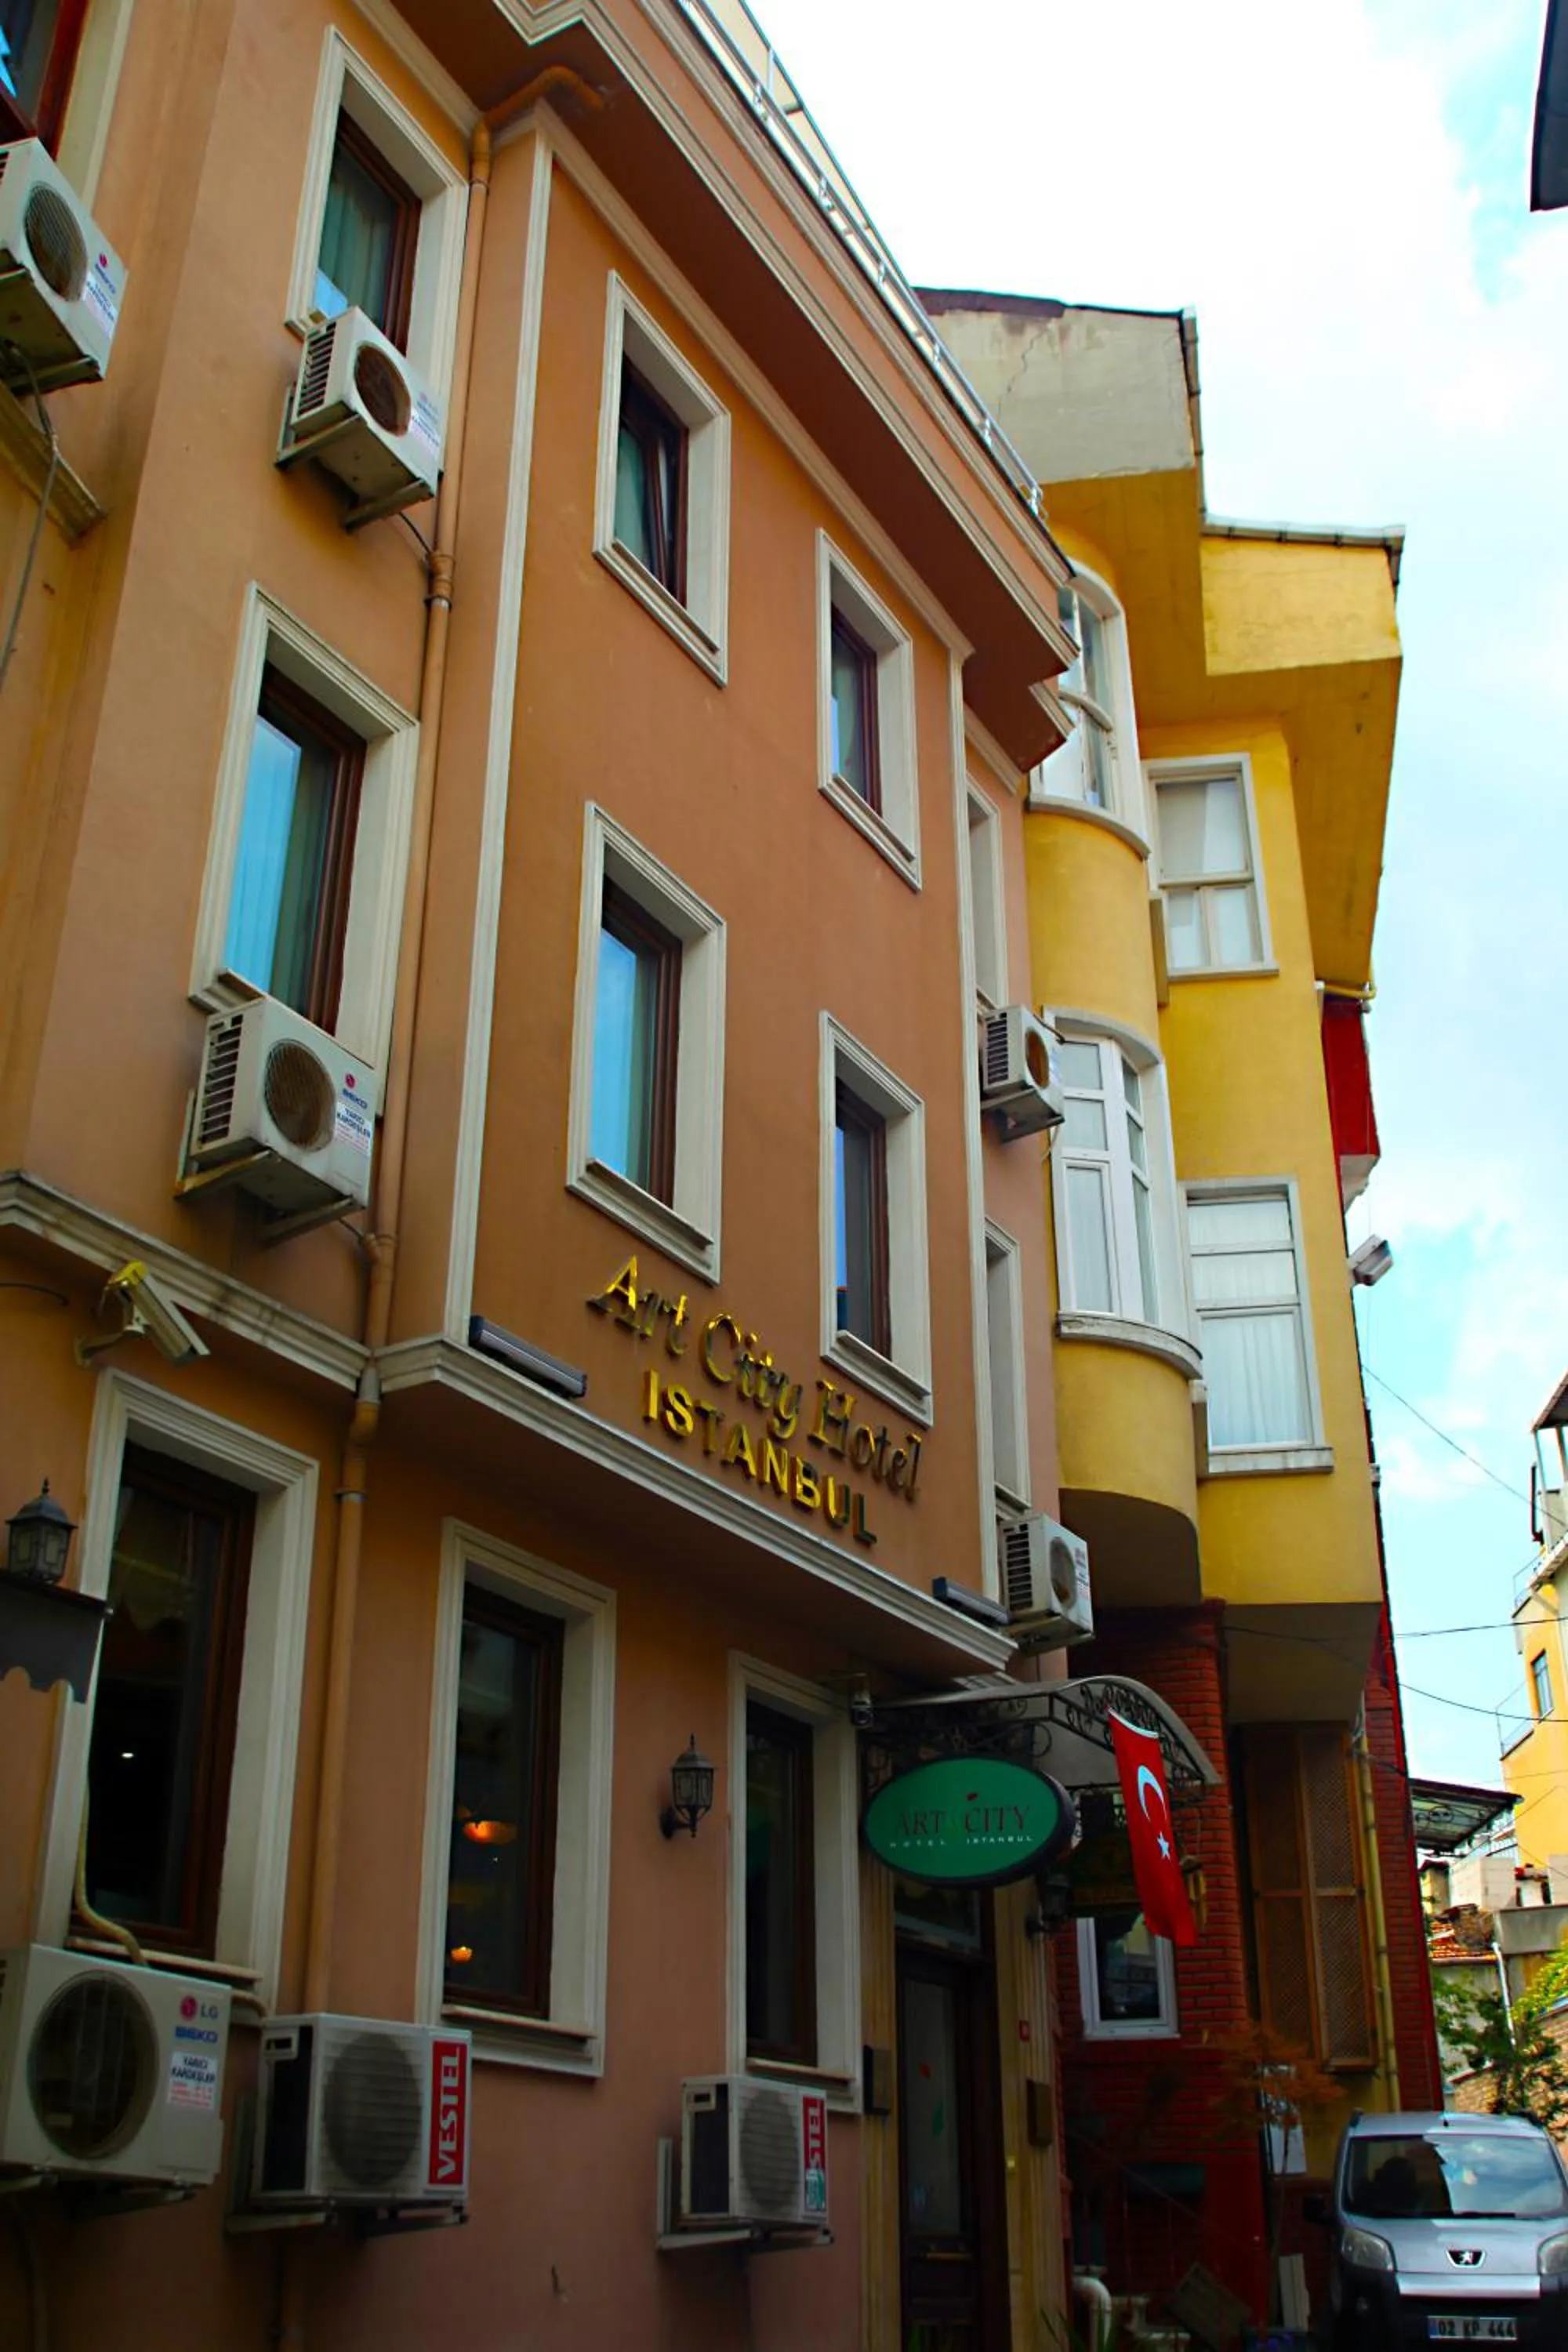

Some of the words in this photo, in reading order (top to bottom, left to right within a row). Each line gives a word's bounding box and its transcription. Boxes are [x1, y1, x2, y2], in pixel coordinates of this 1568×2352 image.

[586, 1254, 688, 1356] Art
[699, 1313, 803, 1439] City
[808, 1378, 923, 1504] Hotel
[642, 1367, 877, 1546] ISTANBUL
[896, 1809, 946, 1836] ART
[964, 1806, 1030, 1833] CITY
[966, 1835, 1033, 1844] ISTANBUL
[437, 2046, 460, 2180] VESTEL
